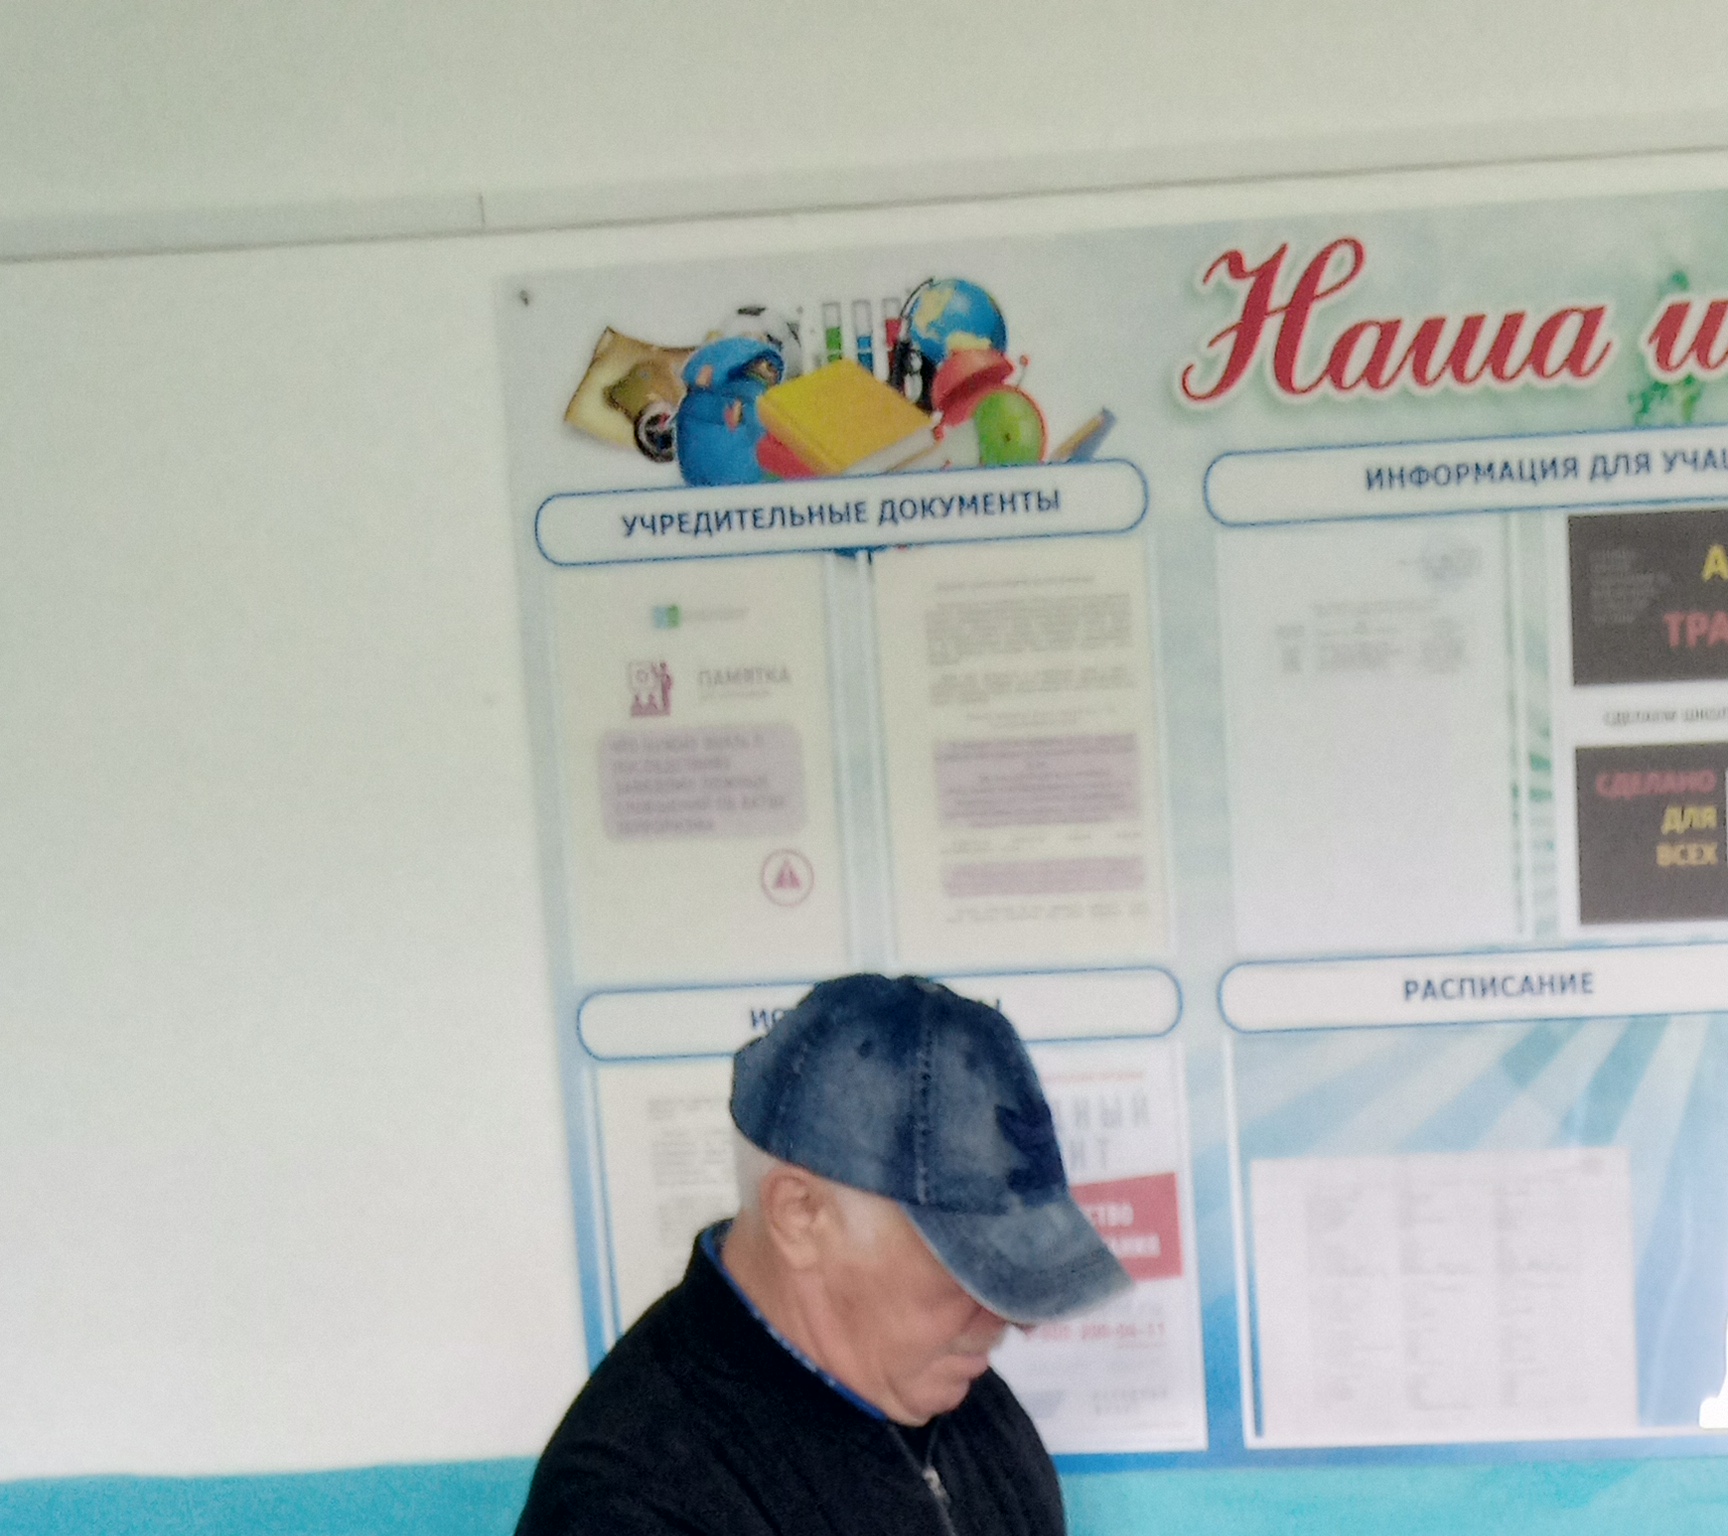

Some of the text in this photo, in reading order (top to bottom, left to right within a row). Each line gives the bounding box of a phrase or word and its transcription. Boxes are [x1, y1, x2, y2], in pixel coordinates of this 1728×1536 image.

[1181, 237, 1612, 402] Наша
[1365, 456, 1579, 491] ИНФОРМАЦИЯ
[1588, 452, 1653, 482] ДЛЯ
[621, 490, 1060, 537] УЧРЕДИТЕЛЬНЫЕ ДОКУМЕНТЫ
[1661, 805, 1718, 835] ДЛЯ
[1656, 842, 1718, 867] ВСЕХ
[1403, 971, 1595, 1001] РАСПИСАНИЕ
